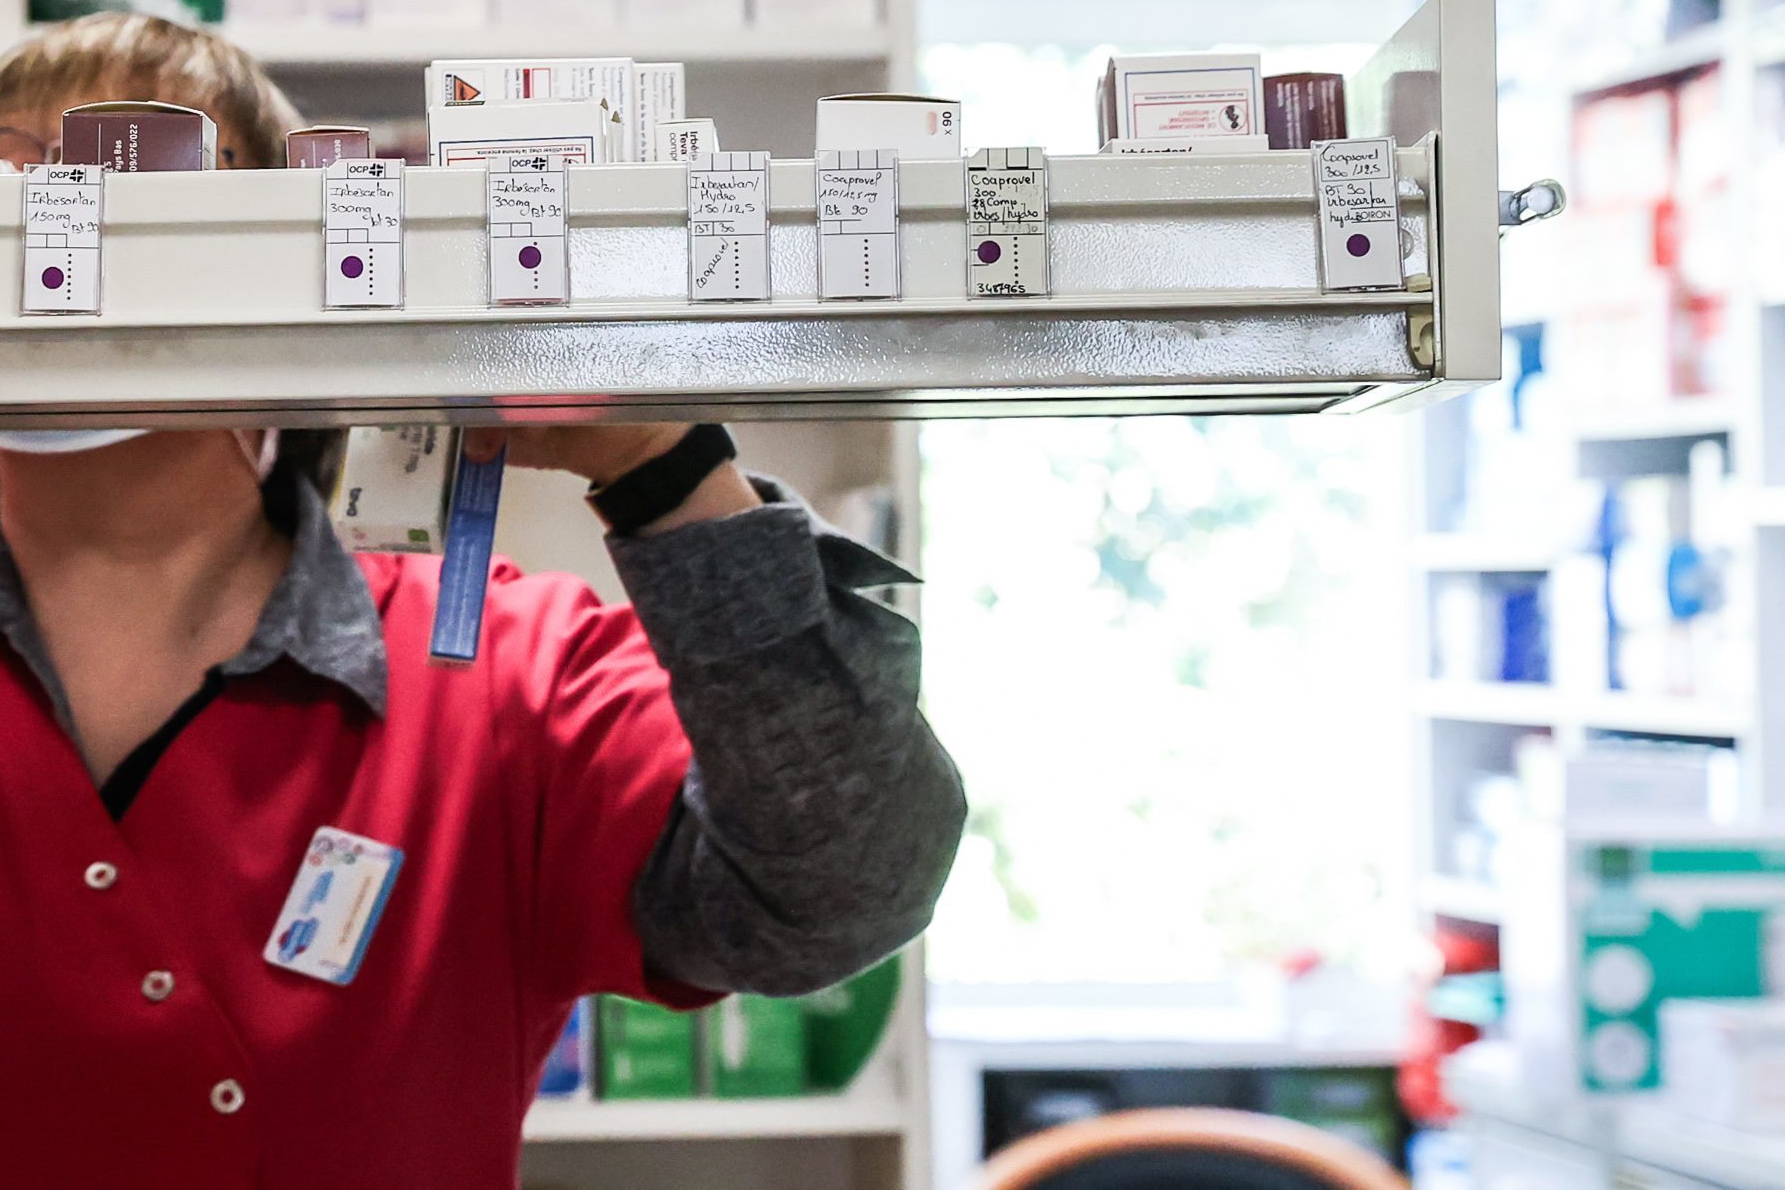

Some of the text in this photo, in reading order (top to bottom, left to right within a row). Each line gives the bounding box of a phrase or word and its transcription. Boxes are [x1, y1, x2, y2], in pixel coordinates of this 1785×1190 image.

[680, 132, 689, 155] Teva
[512, 159, 531, 167] OCP
[349, 166, 369, 174] OCP
[50, 171, 69, 179] OCP
[971, 171, 1035, 190] Coaprovel
